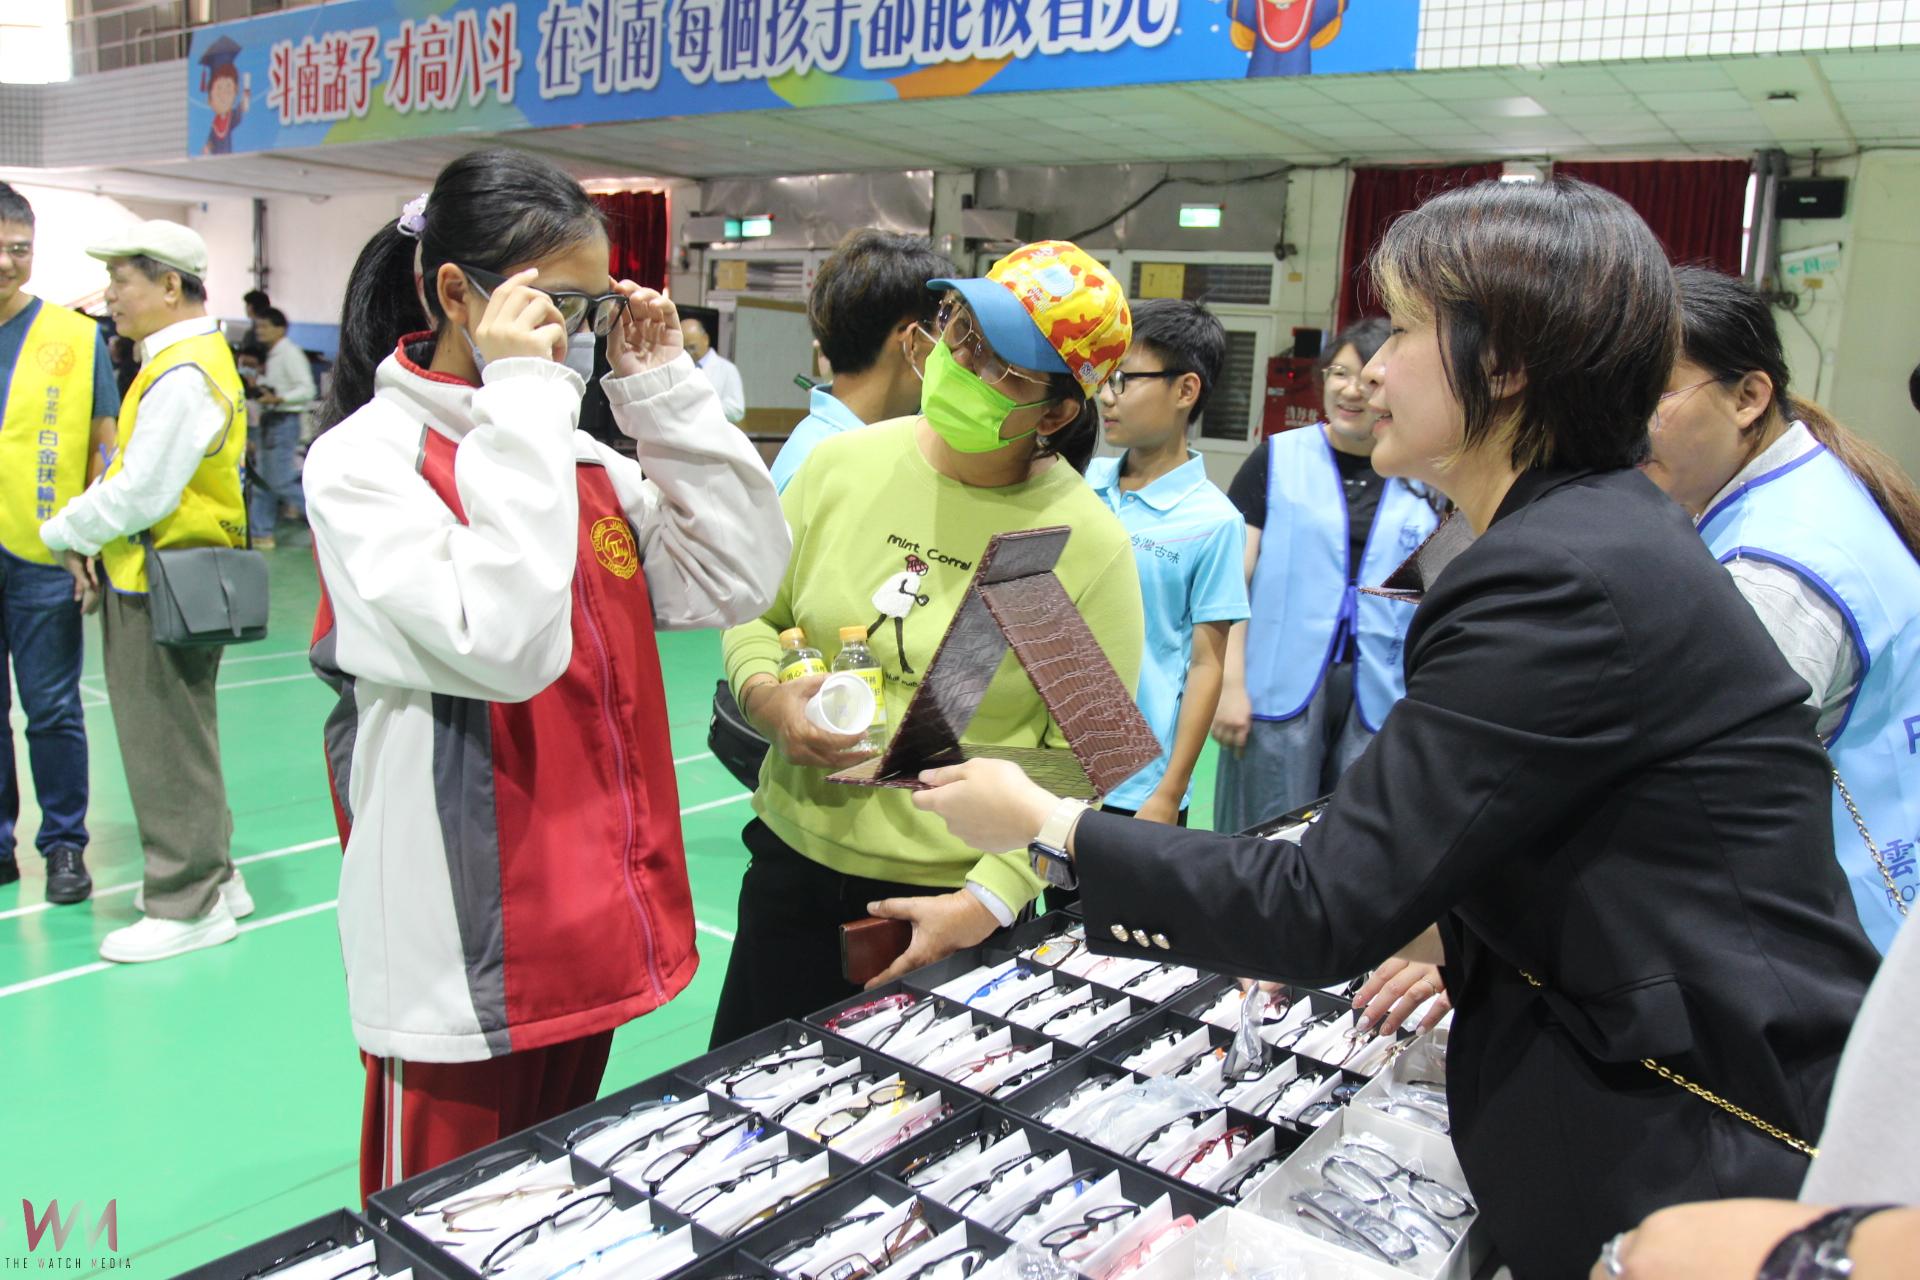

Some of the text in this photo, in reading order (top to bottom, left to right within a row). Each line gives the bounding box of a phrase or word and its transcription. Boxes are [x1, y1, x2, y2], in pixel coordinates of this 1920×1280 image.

[270, 33, 379, 119] 斗南諸子
[387, 12, 517, 106] 才高八斗
